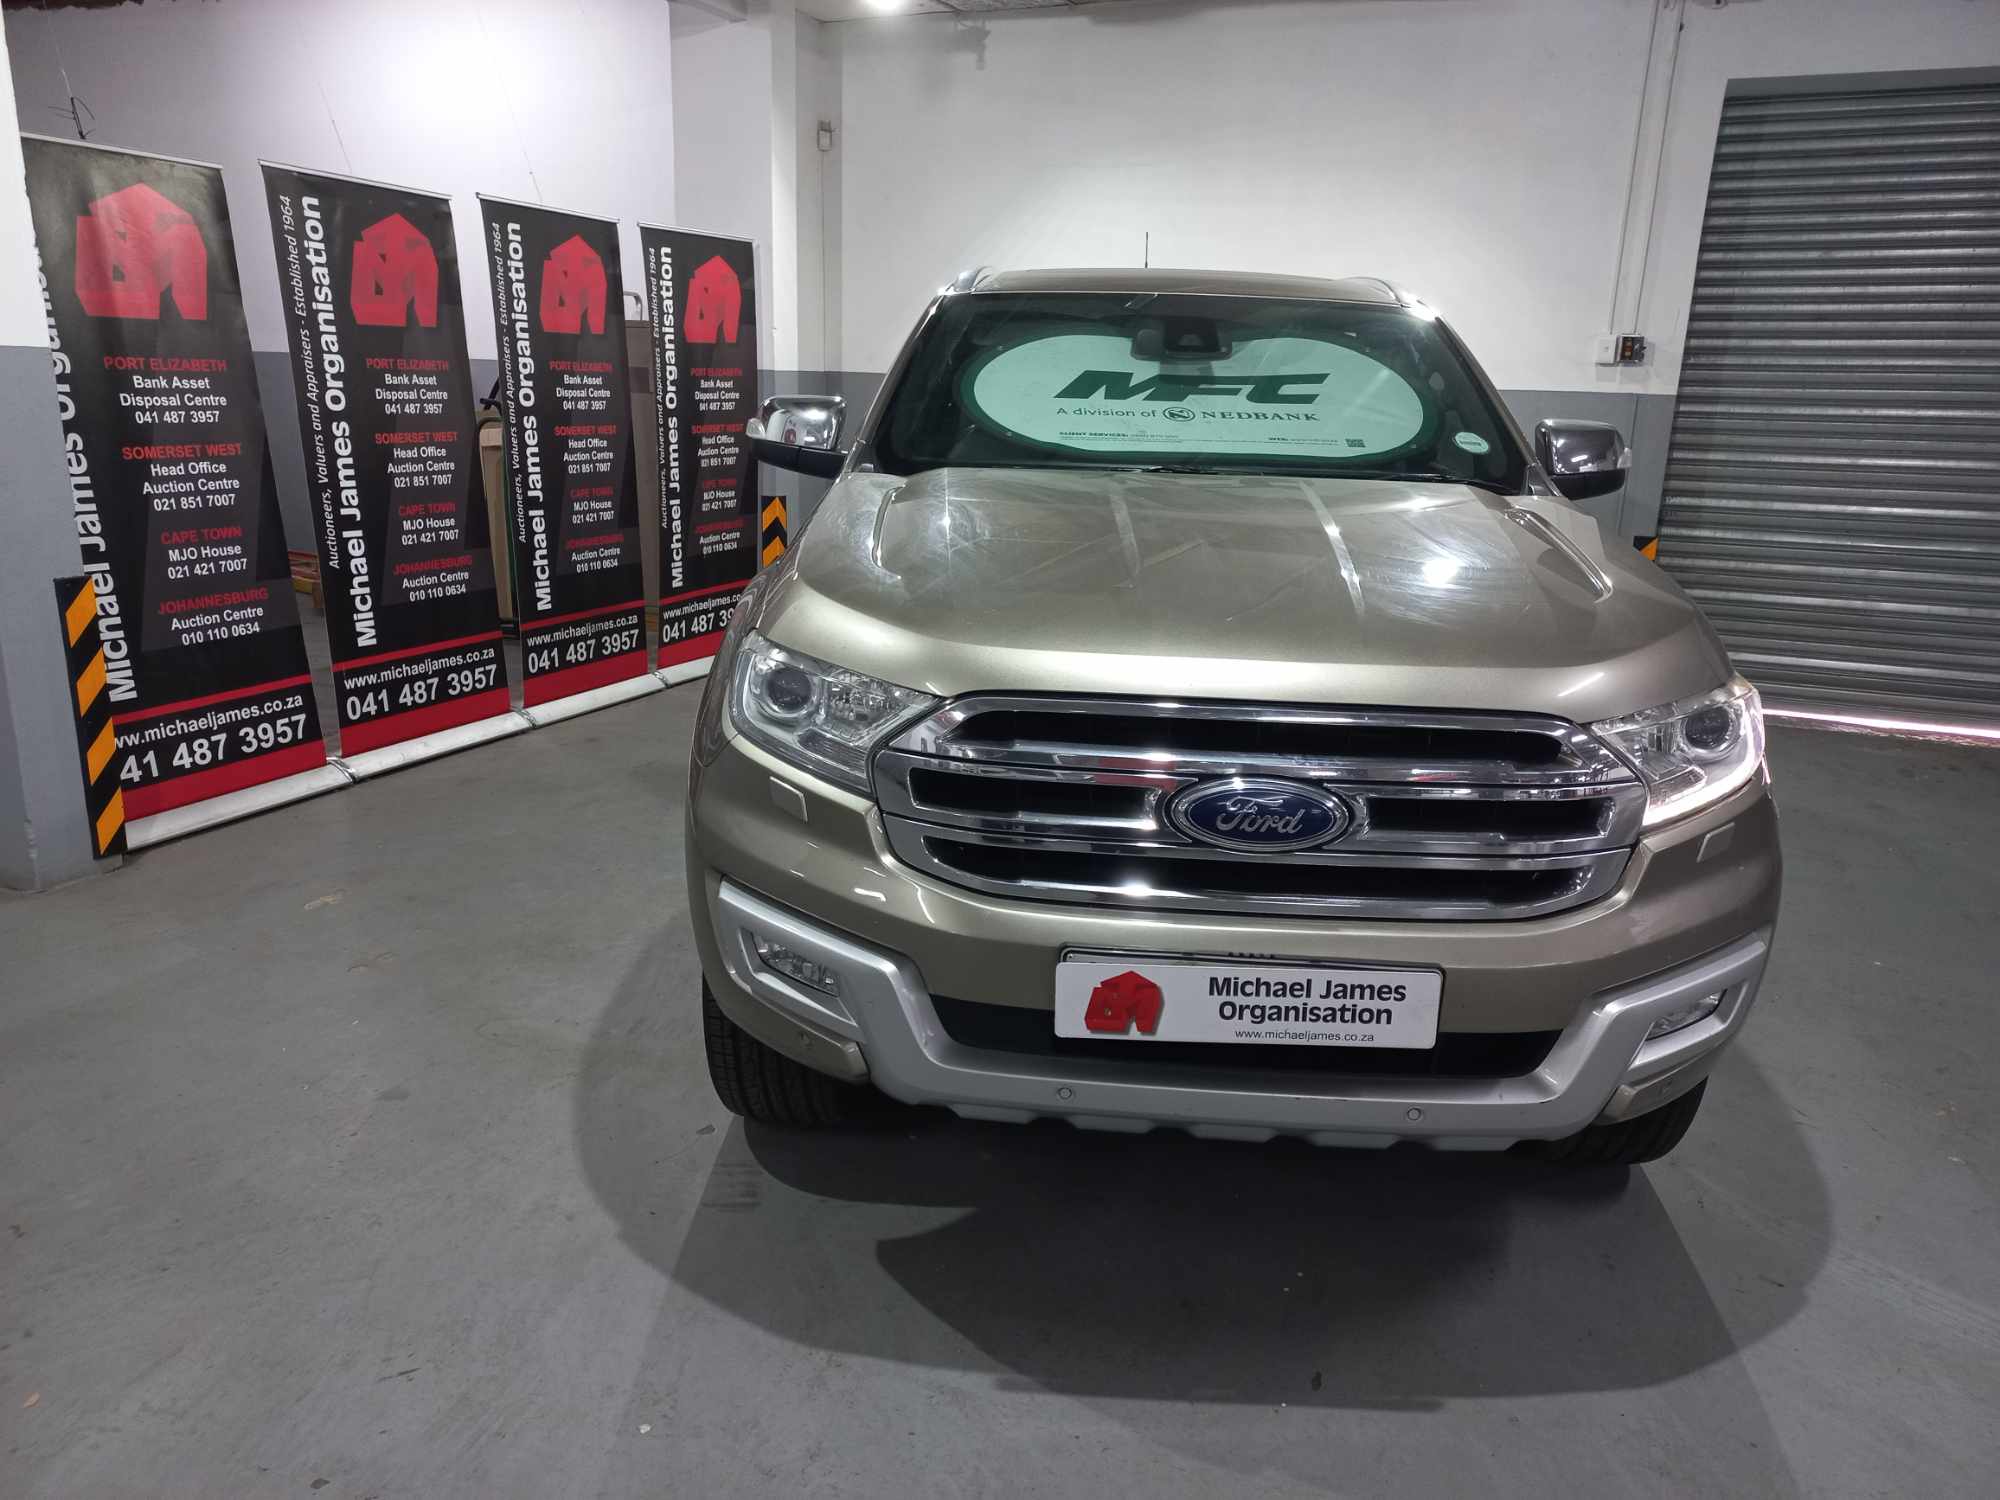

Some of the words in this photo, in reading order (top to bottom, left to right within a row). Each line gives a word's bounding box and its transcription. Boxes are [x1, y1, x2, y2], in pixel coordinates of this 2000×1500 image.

[279, 195, 296, 231] 1964
[491, 222, 502, 254] 1964
[288, 231, 307, 316] Established
[302, 196, 346, 411] Organisation
[507, 222, 536, 408] Organisation
[660, 246, 678, 410] Organisation
[104, 356, 145, 370] PORT
[150, 358, 226, 372] ELIZABETH
[301, 329, 319, 400] Appraisers
[366, 357, 393, 370] PORT
[502, 336, 516, 400] Appraisers
[133, 375, 168, 390] Bank
[172, 376, 210, 390] Asset
[384, 373, 410, 385] Bank
[412, 373, 437, 385] Asset
[563, 374, 581, 385] Bank
[583, 375, 603, 385] Asset
[1053, 369, 1330, 405] MFC
[120, 393, 181, 408] Disposal
[184, 394, 227, 406] Centre
[375, 388, 418, 402] Disposal
[420, 389, 448, 400] Centre
[556, 387, 587, 399] Disposal
[588, 388, 611, 398] Centre
[384, 403, 401, 415] 041
[404, 403, 420, 415] 487
[423, 403, 443, 414] 3957
[508, 399, 517, 424] and
[563, 400, 575, 410] 041
[577, 400, 589, 410] 487
[591, 400, 607, 410] 3957
[1056, 407, 1068, 416] A
[1072, 407, 1136, 417] division
[1140, 409, 1158, 417] of
[135, 410, 159, 424] 041
[163, 410, 187, 424] 487
[191, 410, 220, 424] 3957
[310, 405, 322, 433] and
[1200, 410, 1321, 422] NEDBANK
[375, 432, 430, 445] SOMERSET
[511, 424, 520, 470] Valuers
[568, 439, 586, 449] Head
[587, 438, 608, 448] Office
[121, 444, 204, 460] SOMERSET
[207, 442, 241, 457] WEST
[316, 433, 328, 483] Valuers
[394, 448, 418, 459] Head
[420, 446, 446, 457] Office
[523, 417, 544, 502] James
[563, 452, 590, 462] Auction
[592, 450, 614, 460] Centre
[668, 416, 681, 493] James
[151, 462, 184, 477] Head
[188, 460, 227, 474] Office
[332, 421, 362, 522] James
[387, 463, 424, 474] Auction
[426, 460, 455, 471] Centre
[568, 465, 580, 474] 021
[582, 463, 594, 473] 851
[595, 462, 611, 472] 7007
[142, 480, 196, 495] Auction
[199, 477, 240, 491] Centre
[394, 477, 410, 488] 021
[413, 476, 429, 487] 851
[432, 474, 452, 485] 7007
[153, 498, 177, 512] 021
[181, 496, 203, 510] 851
[207, 494, 236, 507] 7007
[573, 502, 589, 512] MJO
[590, 500, 612, 509] House
[402, 519, 424, 531] MJO
[426, 516, 455, 529] House
[572, 514, 584, 524] 021
[586, 513, 597, 522] 421
[599, 511, 615, 520] 7007
[161, 530, 198, 546] CAPE
[201, 526, 242, 542] TOWN
[321, 488, 341, 569] Auctioneers,
[402, 534, 418, 546] 021
[420, 531, 436, 543] 421
[439, 529, 459, 541] 7007
[670, 497, 684, 588] Michael
[168, 548, 198, 562] MJO
[201, 544, 242, 559] House
[529, 509, 552, 612] Michael
[571, 551, 597, 562] Auction
[599, 547, 621, 557] Centre
[168, 566, 191, 580] 021
[194, 562, 216, 576] 421
[219, 558, 248, 573] 7007
[576, 563, 588, 573] 010
[590, 561, 601, 571] 110
[602, 558, 619, 569] 0634
[342, 529, 377, 648] Michael
[402, 575, 438, 589] Auction
[440, 570, 469, 583] Centre
[158, 587, 269, 615] JOHANNESBURG
[410, 590, 425, 602] 010
[428, 586, 443, 599] 110
[445, 583, 467, 596] 0634
[171, 613, 221, 631] Auction
[224, 605, 264, 621] Centre
[663, 620, 686, 643] 041
[691, 612, 715, 634] 487
[719, 607, 736, 627] 39
[182, 632, 204, 646] 010
[208, 627, 229, 642] 110
[232, 622, 260, 637] 0634
[527, 614, 639, 647] www.michaeljames.co.za
[528, 647, 560, 675] 041
[566, 638, 596, 665] 487
[602, 629, 640, 656] 3957
[344, 647, 495, 691] www.michaeljames.co.za
[346, 689, 390, 721] 041
[399, 677, 440, 709] 487
[447, 664, 497, 696] 3957
[114, 695, 303, 750] ww.michaeljames.co.za
[120, 750, 160, 783] 41
[172, 733, 228, 769] 487
[239, 713, 307, 754] 3957
[1215, 795, 1304, 834] Ford
[1208, 975, 1313, 1001] Michael
[1319, 977, 1407, 1002] James
[1218, 1000, 1394, 1026] Organisation
[1234, 1028, 1375, 1043] www.michaeljames.co.za
